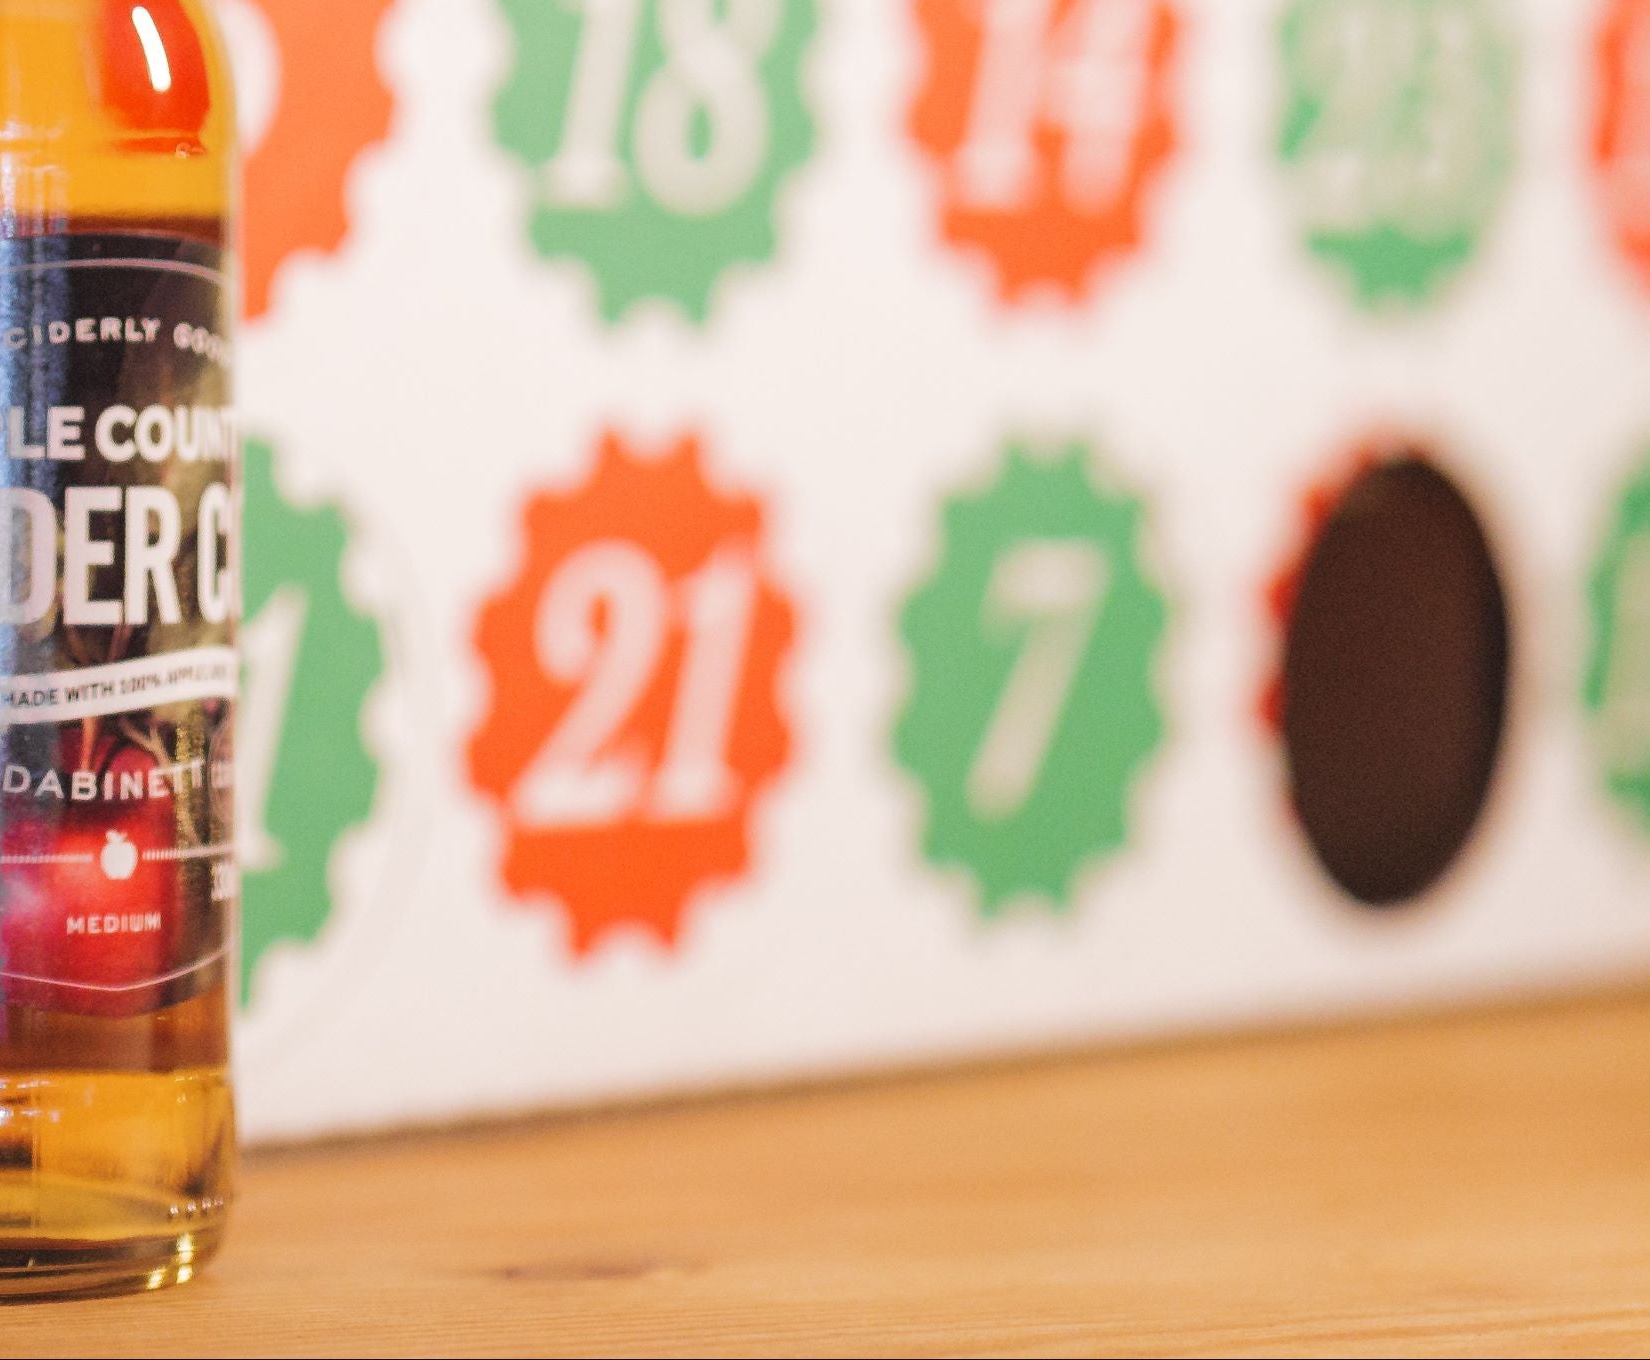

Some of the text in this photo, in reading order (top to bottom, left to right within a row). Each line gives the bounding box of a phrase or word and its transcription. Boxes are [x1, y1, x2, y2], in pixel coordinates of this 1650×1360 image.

[512, 539, 759, 831] 21
[980, 539, 1112, 822] 7
[2, 759, 202, 802] DABINETT
[66, 912, 162, 936] MEDIUM
